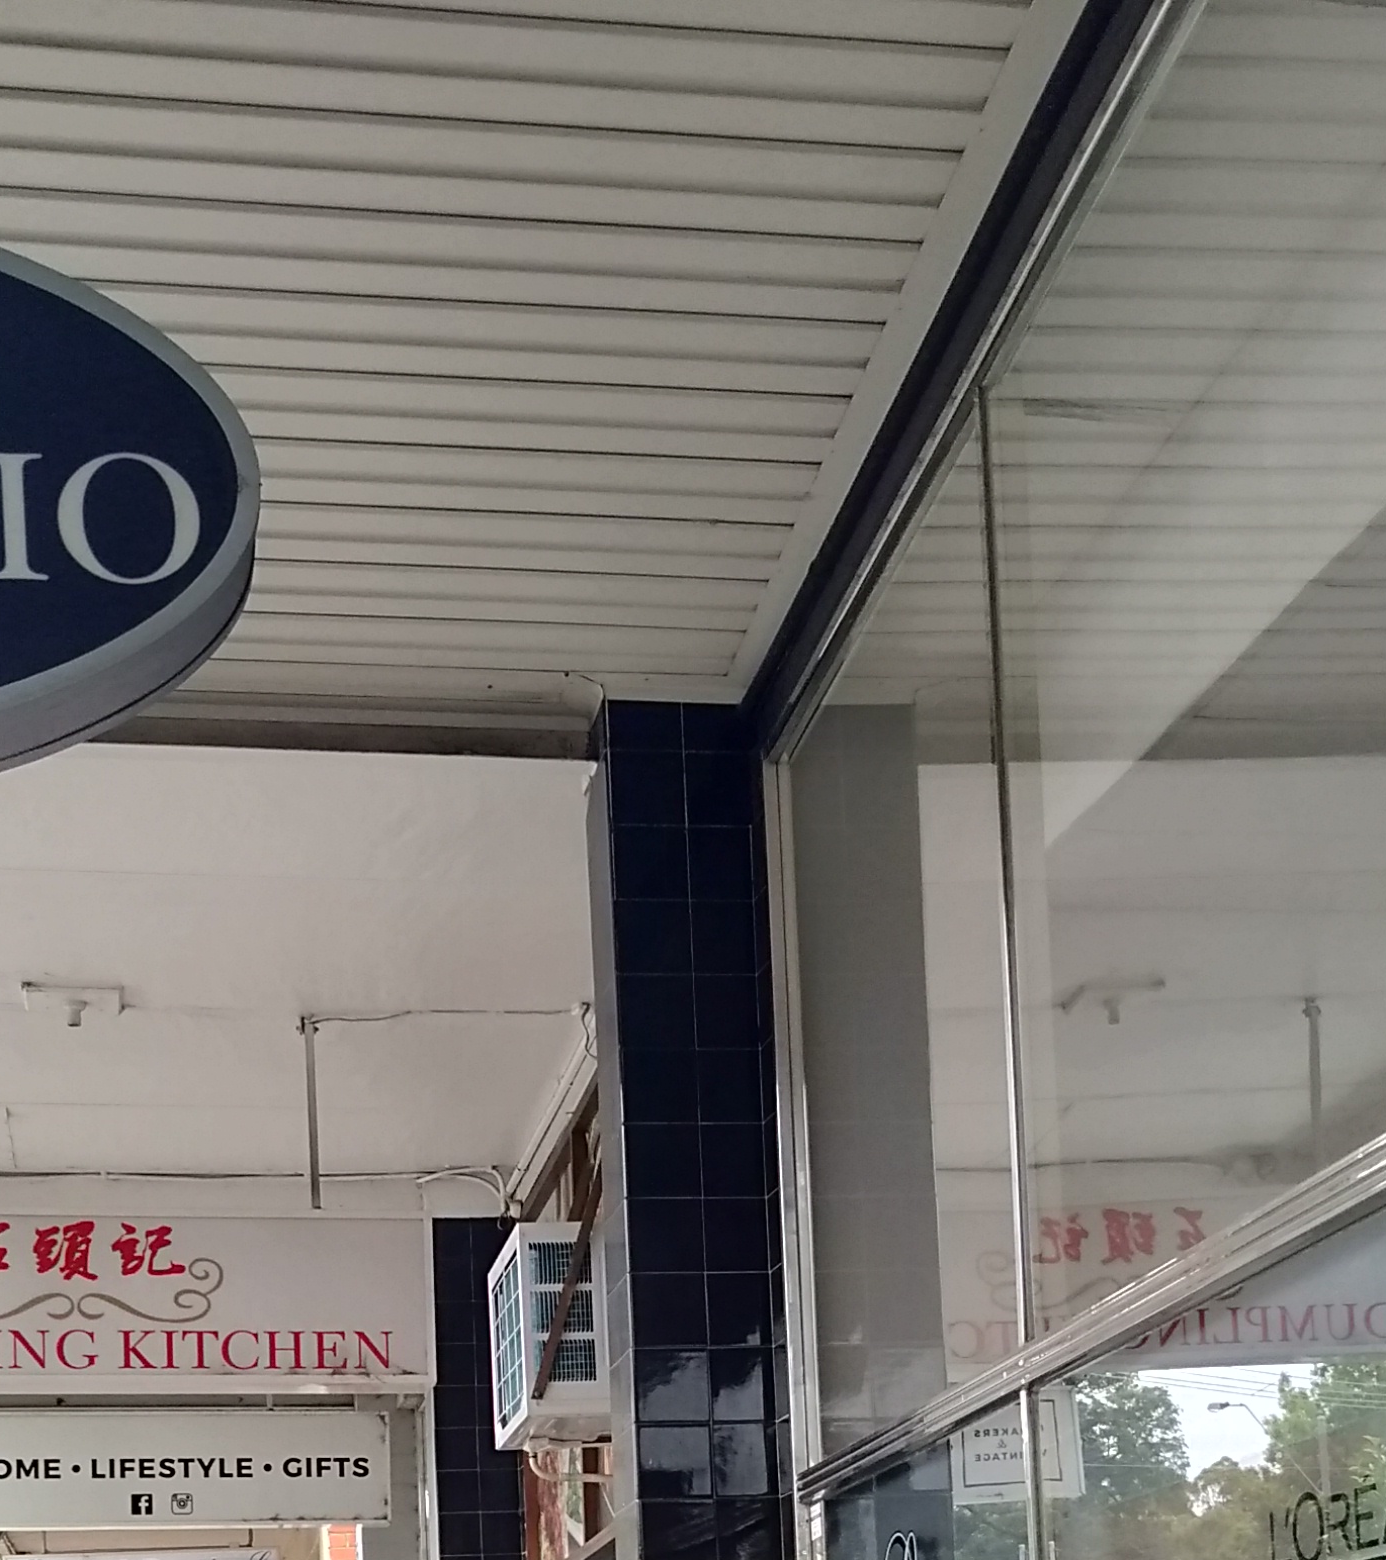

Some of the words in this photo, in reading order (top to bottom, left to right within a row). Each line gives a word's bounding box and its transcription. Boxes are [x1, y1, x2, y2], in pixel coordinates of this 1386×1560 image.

[118, 1329, 395, 1371] KITCHEN
[90, 1456, 254, 1480] LIFESTYLE
[282, 1456, 370, 1479] GIFTS
